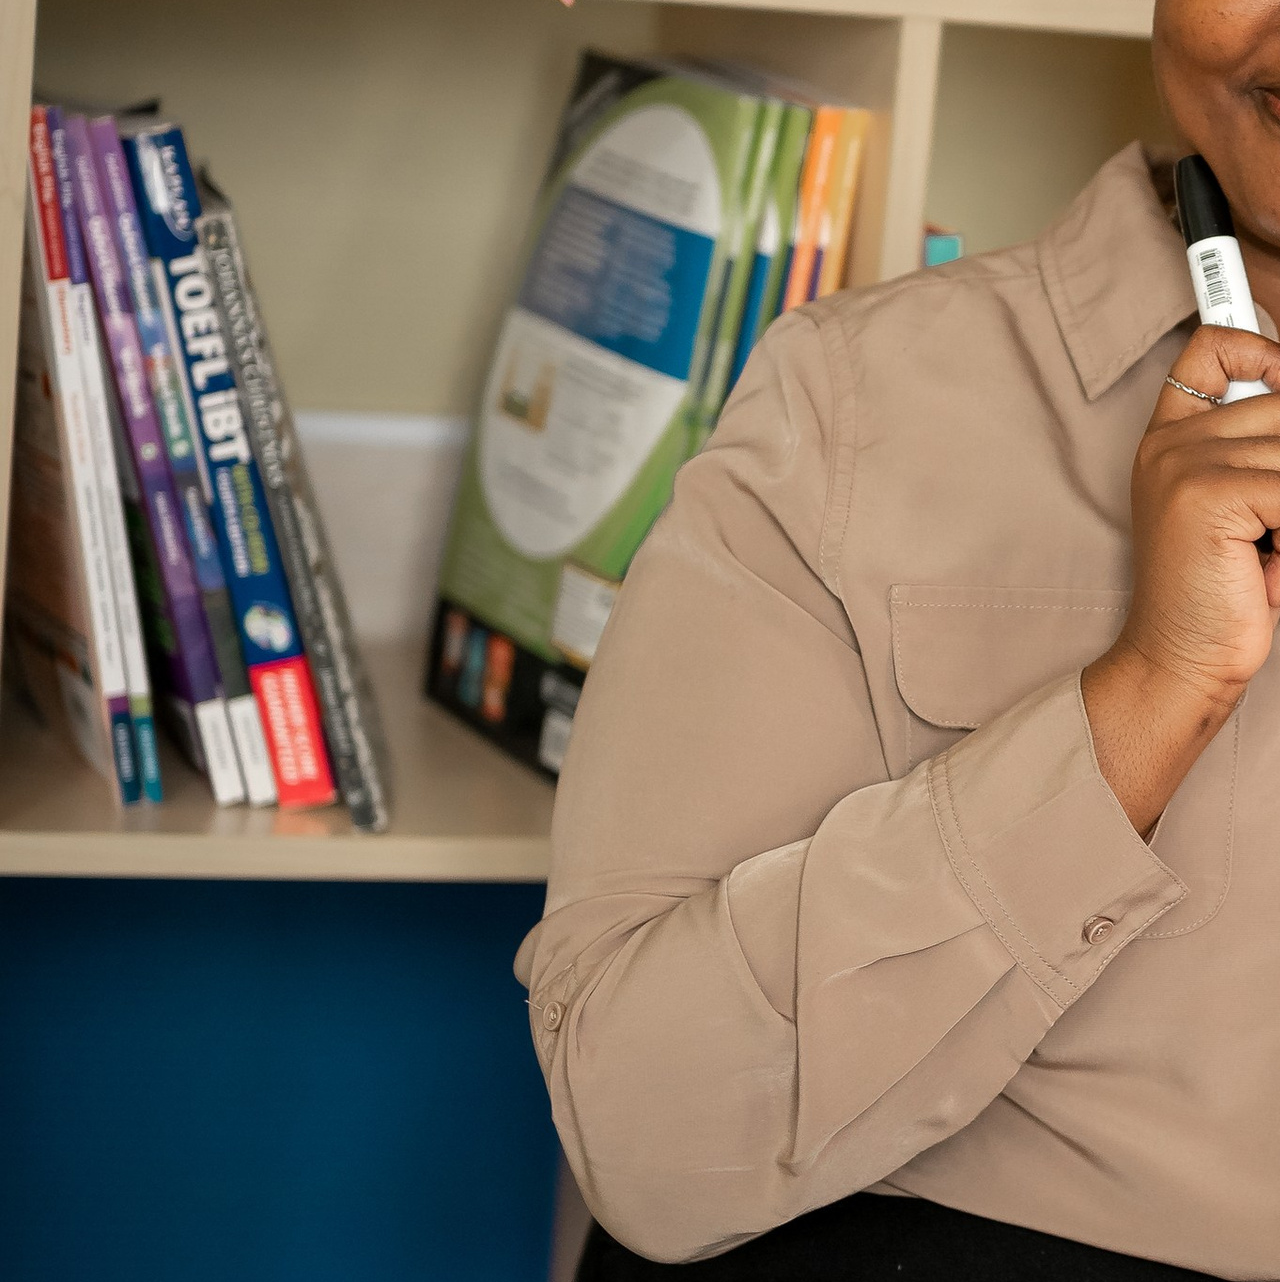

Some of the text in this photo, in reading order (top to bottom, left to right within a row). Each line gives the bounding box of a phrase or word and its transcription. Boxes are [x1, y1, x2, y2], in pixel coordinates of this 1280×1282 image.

[157, 143, 195, 232] KAPLAN
[164, 245, 235, 390] TOEFL
[195, 387, 253, 469] iBT
